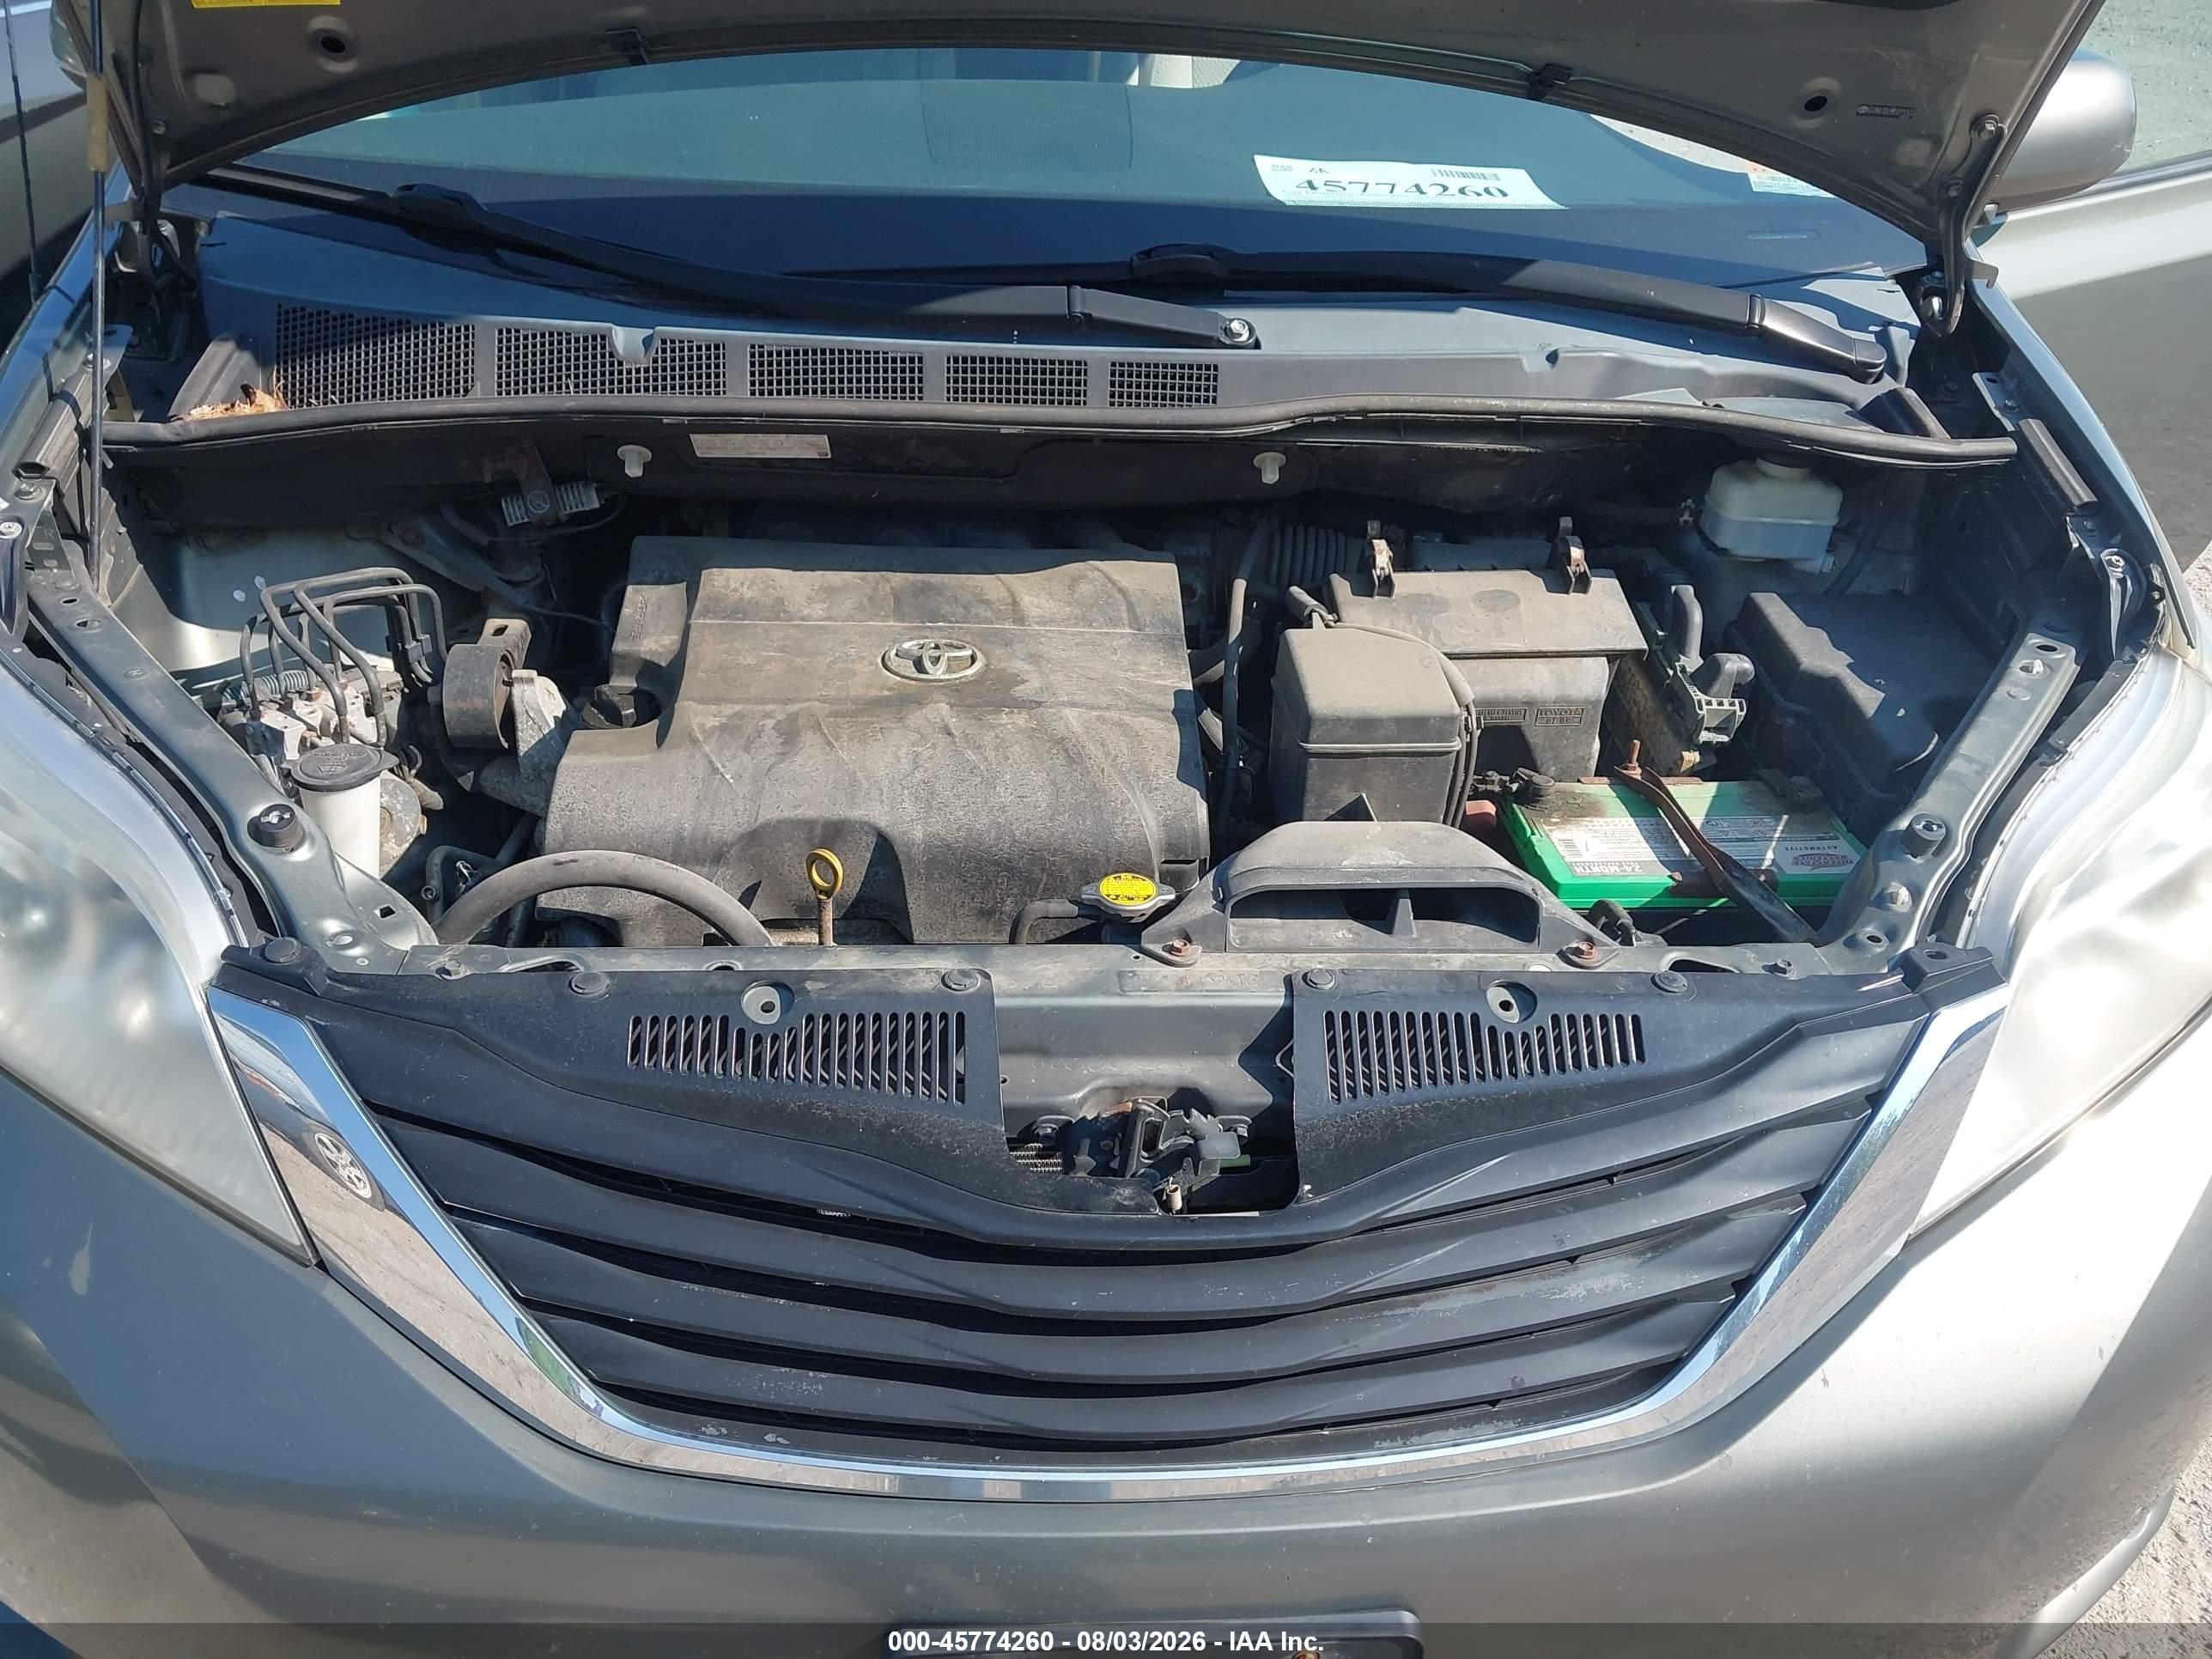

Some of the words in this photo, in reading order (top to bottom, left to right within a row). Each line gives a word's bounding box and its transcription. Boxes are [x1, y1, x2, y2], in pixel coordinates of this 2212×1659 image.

[1295, 179, 1510, 198] 45774260
[1539, 708, 1581, 716] TOYOTA
[1573, 865, 1644, 873] 24-MONTH
